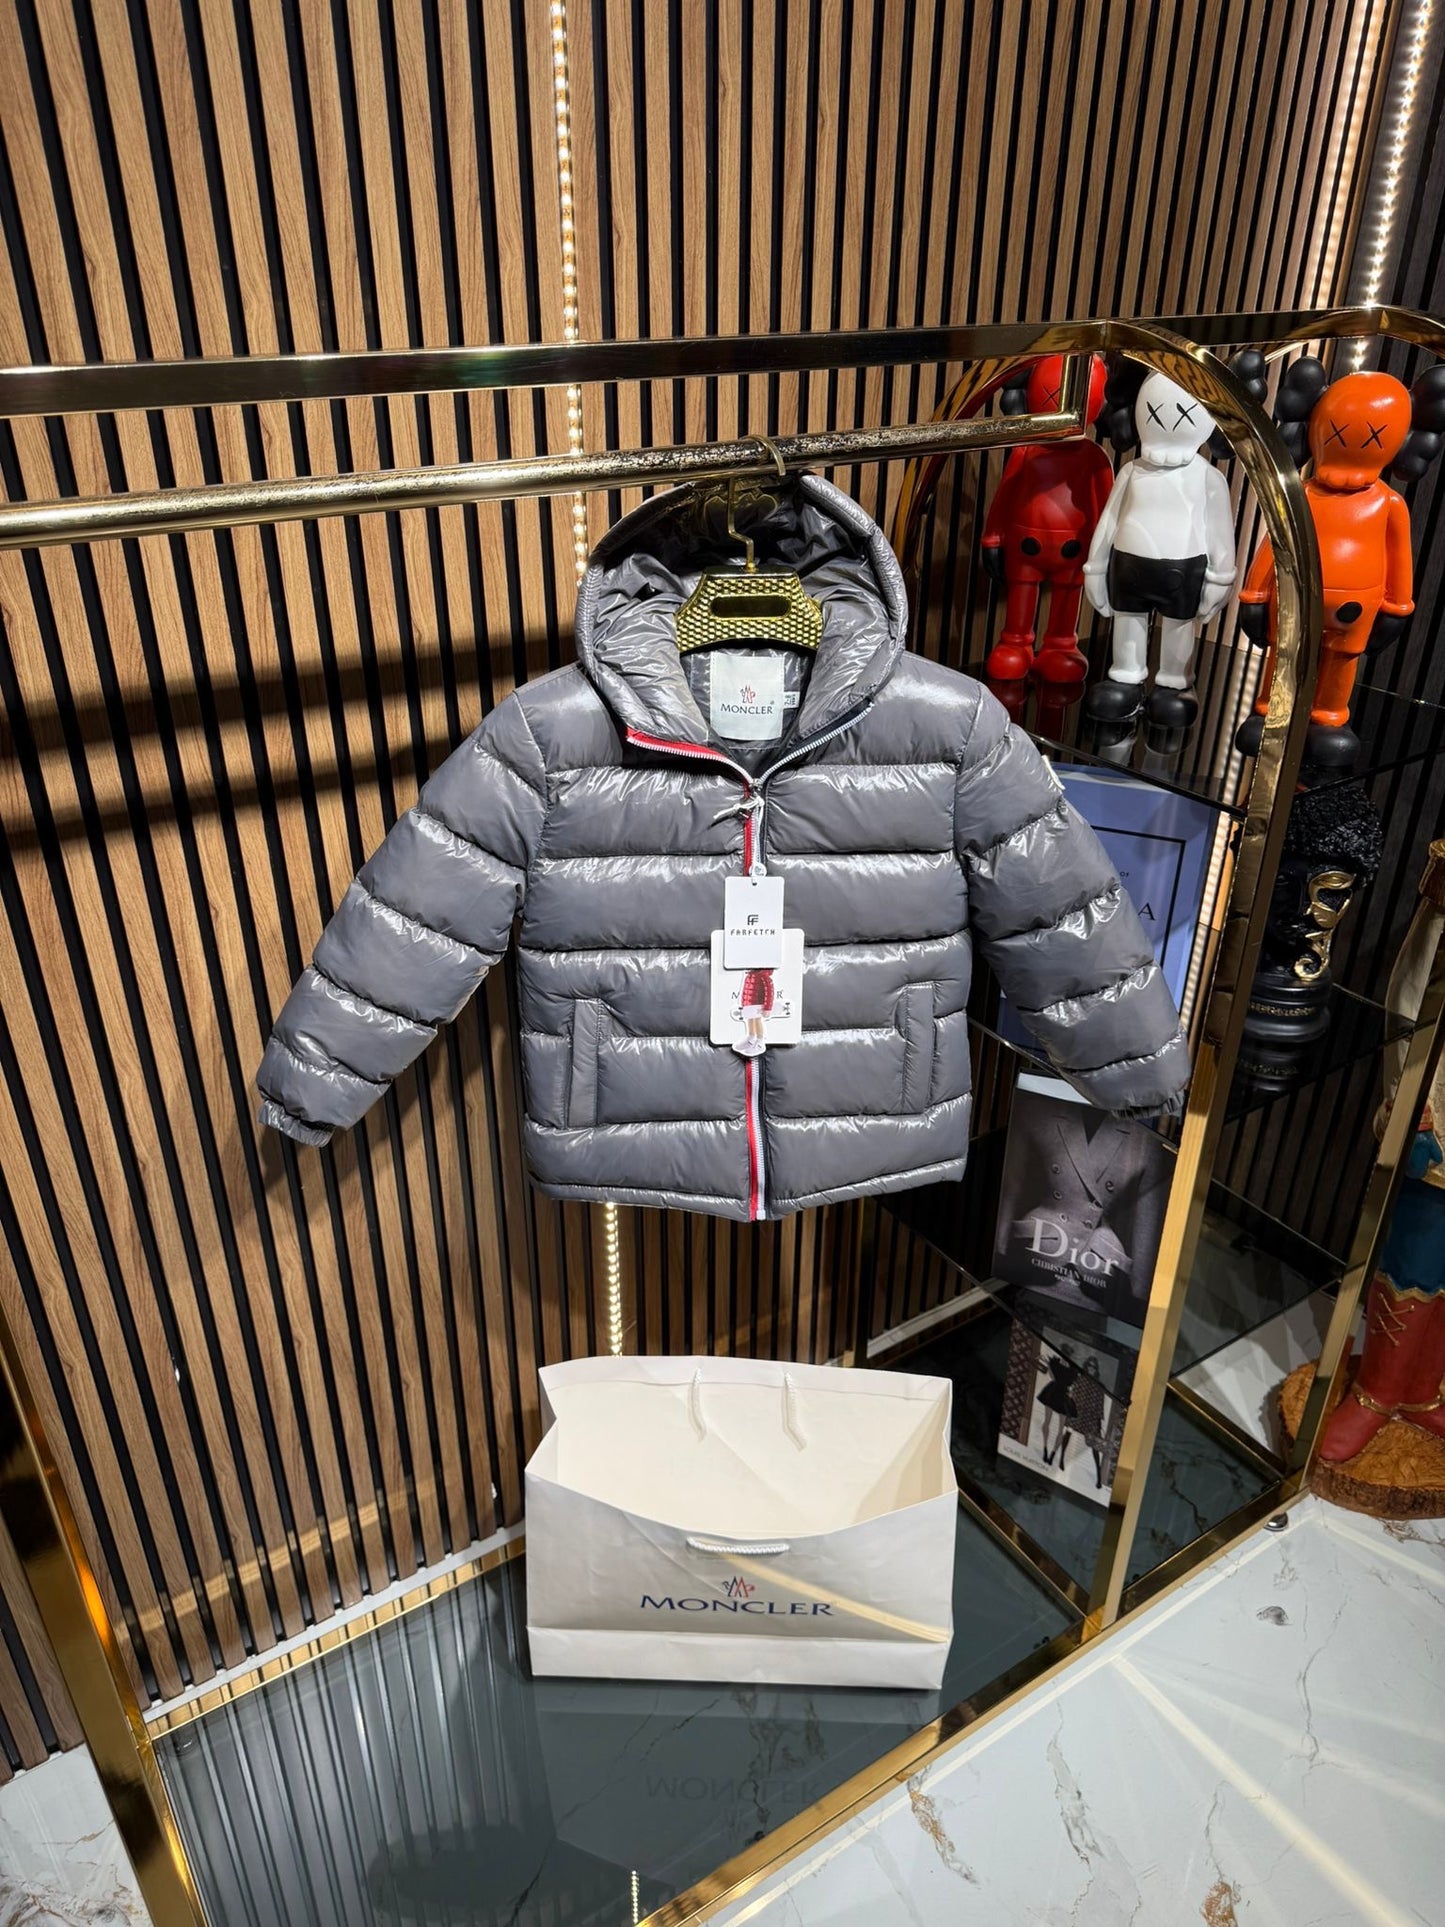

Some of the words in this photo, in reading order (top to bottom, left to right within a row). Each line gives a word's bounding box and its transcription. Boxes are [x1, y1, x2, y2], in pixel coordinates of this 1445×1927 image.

[720, 703, 773, 715] MONCLER
[730, 928, 775, 937] FARFETCH
[1025, 1216, 1119, 1278] Dior
[1031, 1258, 1081, 1280] CHRISTIAN
[1083, 1273, 1107, 1288] DIOR
[640, 1595, 834, 1616] MONCLER
